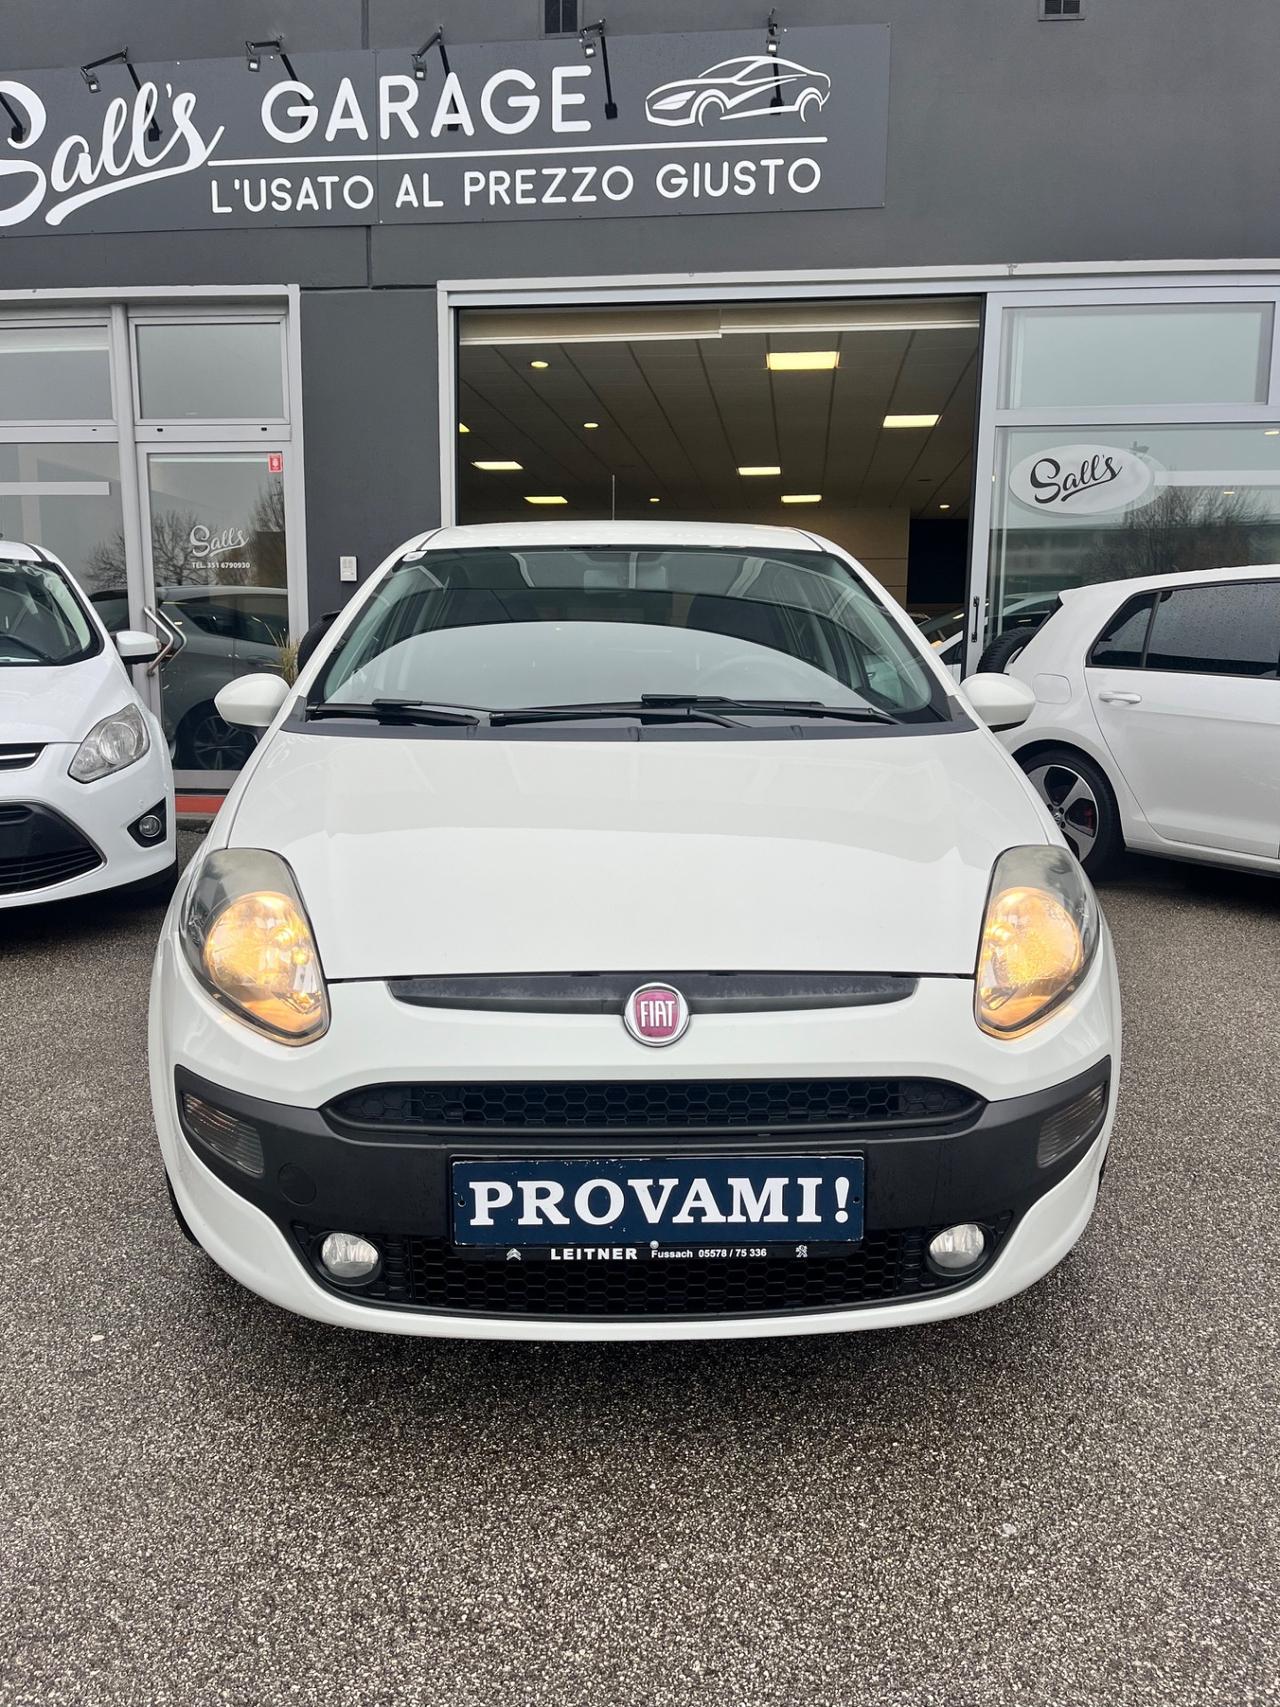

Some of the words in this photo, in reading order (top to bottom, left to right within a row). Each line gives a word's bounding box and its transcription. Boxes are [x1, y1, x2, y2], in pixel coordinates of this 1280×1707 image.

[261, 65, 592, 144] GARAGE
[211, 175, 375, 213] L'USATO
[395, 173, 444, 208] AL
[464, 165, 634, 206] PREZZO
[656, 157, 821, 199] GIUSTO
[1030, 454, 1122, 504] Sall's
[190, 525, 250, 558] Sall's
[640, 1000, 675, 1028] FIAT
[469, 1176, 850, 1226] PROVAMI!
[551, 1248, 638, 1260] LEITNER
[651, 1250, 693, 1258] Fussach
[698, 1249, 727, 1258] 05578
[735, 1248, 747, 1257] 75
[749, 1248, 767, 1257] 336
